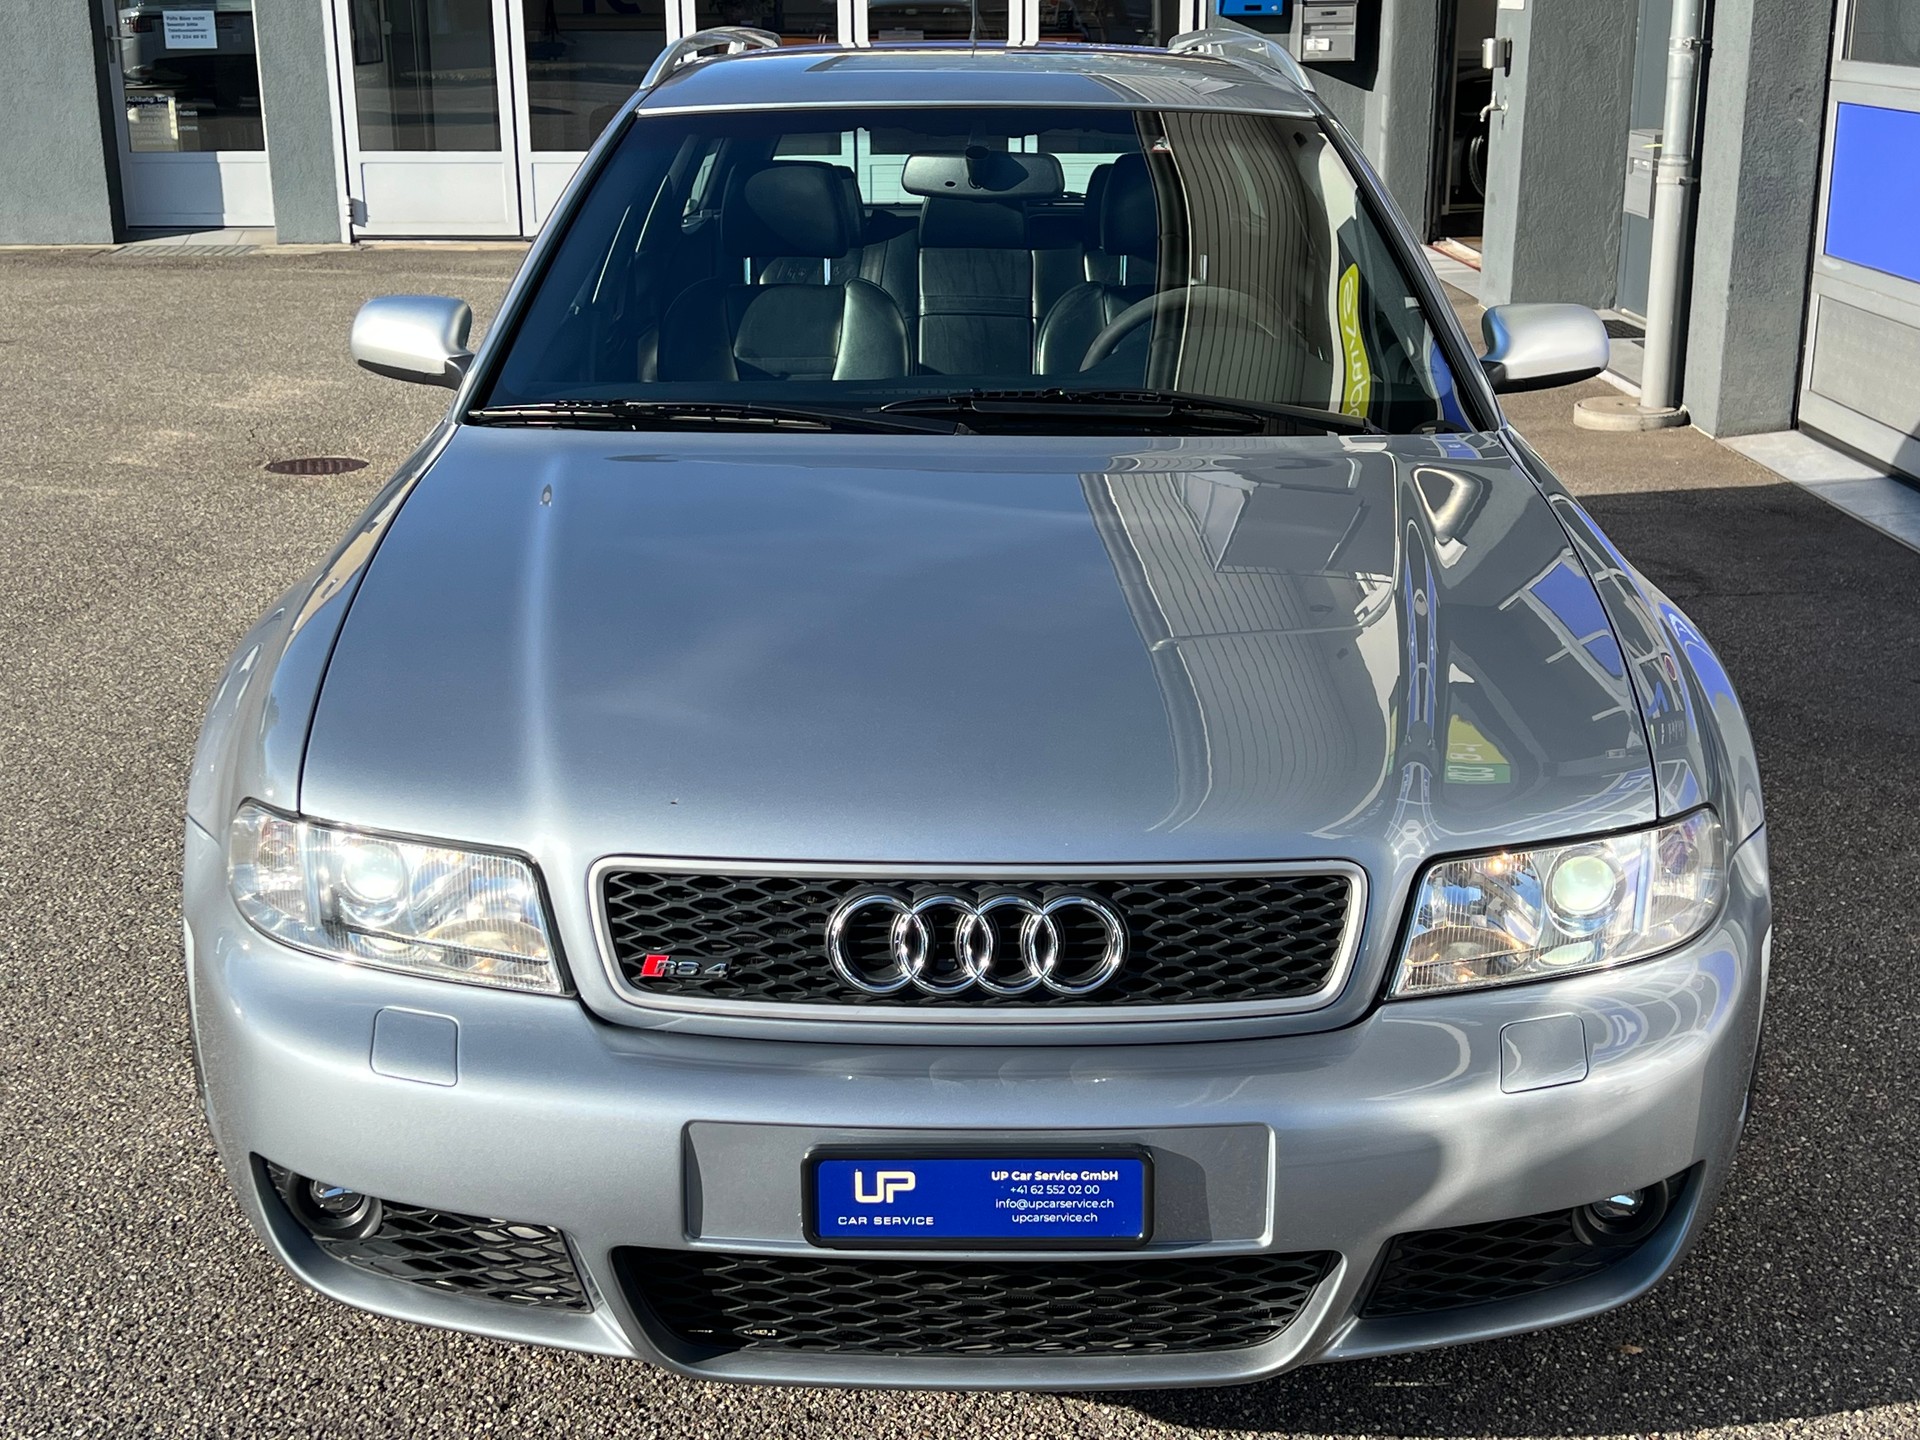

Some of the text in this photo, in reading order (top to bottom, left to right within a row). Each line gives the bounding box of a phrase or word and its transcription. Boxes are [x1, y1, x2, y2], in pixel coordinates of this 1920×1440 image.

[991, 1170, 1119, 1181] UP Car Service GmbH
[855, 1169, 916, 1203] UP
[1010, 1185, 1100, 1195] +41 62 552 02 00
[995, 1198, 1115, 1210] info@upcarservice.ch
[838, 1216, 934, 1226] CAR SERVICE
[1011, 1212, 1098, 1224] upcarservice.ch
